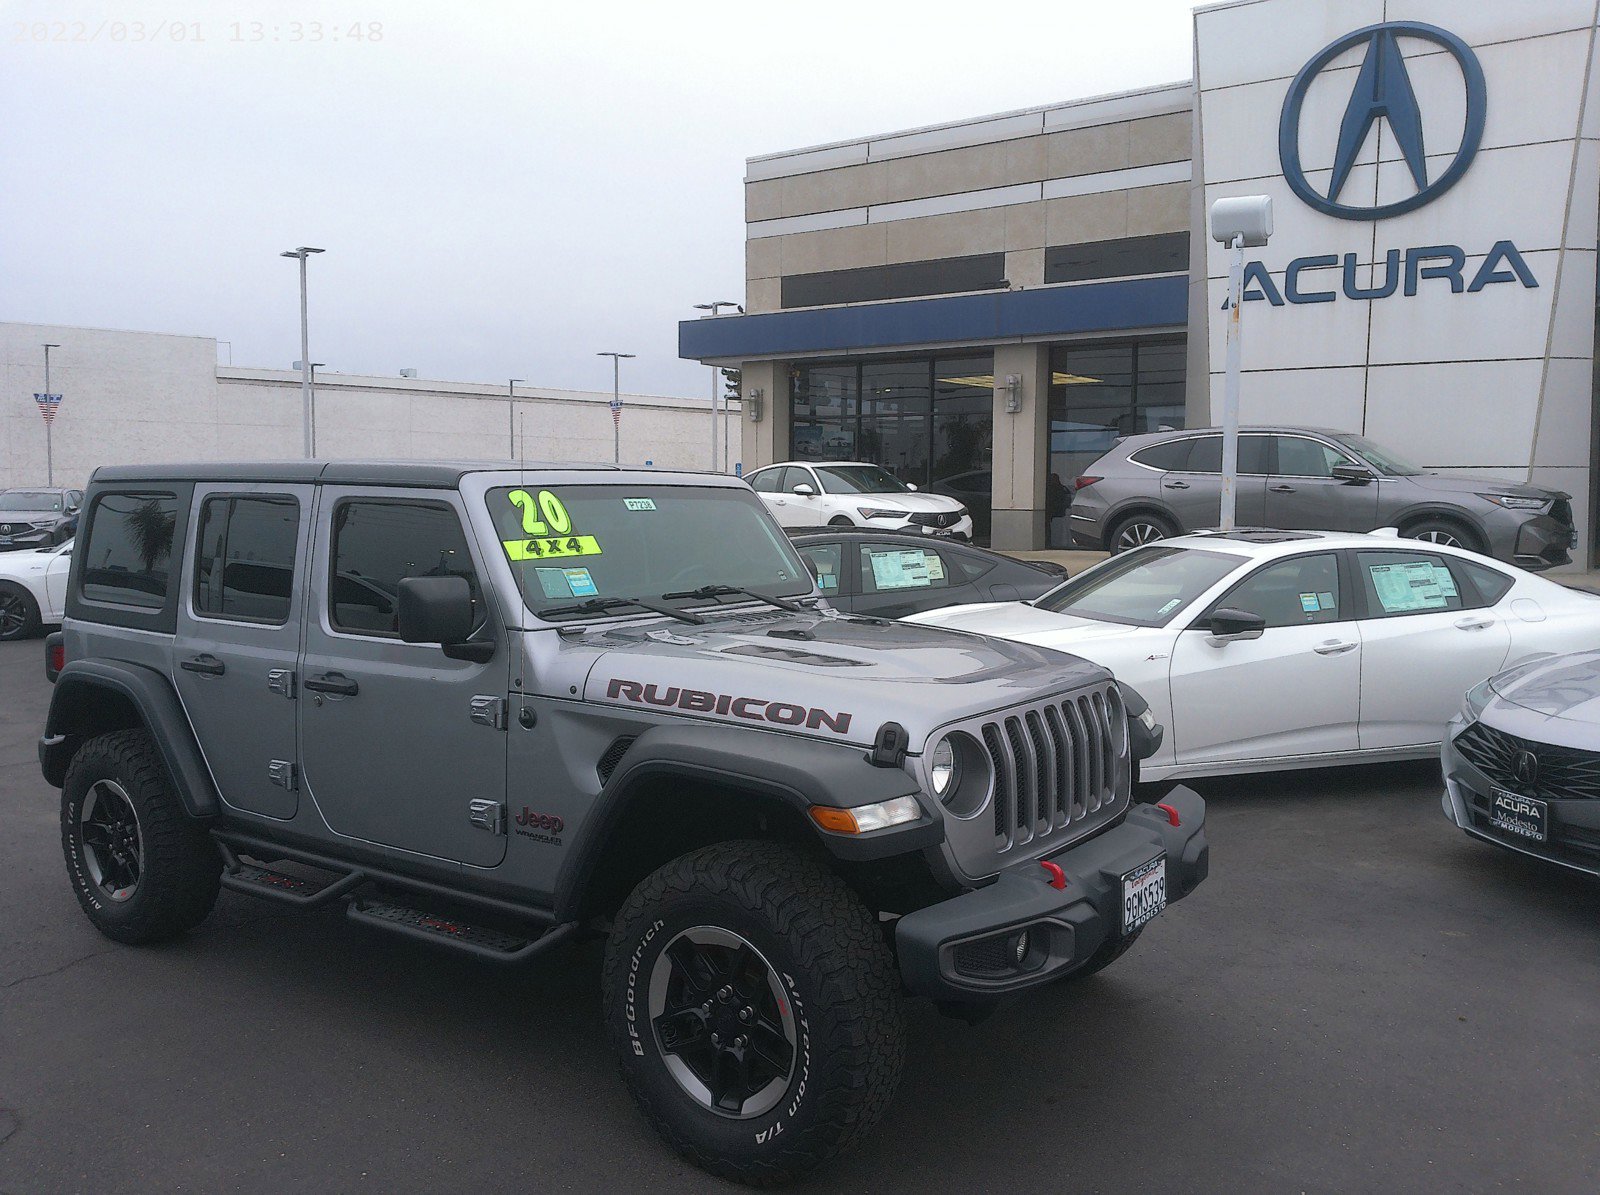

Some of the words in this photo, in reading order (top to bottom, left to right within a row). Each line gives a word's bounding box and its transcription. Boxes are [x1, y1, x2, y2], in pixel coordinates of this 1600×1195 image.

[1221, 240, 1539, 310] ACURA
[508, 489, 572, 536] 20
[606, 678, 853, 734] RUBICON
[515, 805, 564, 836] Jeep
[1495, 796, 1540, 818] ACURA
[1497, 810, 1538, 832] Modesto
[515, 829, 562, 844] WRANGLER
[1500, 822, 1543, 841] MODESTO
[1126, 877, 1165, 925] 9GMS539
[1135, 901, 1166, 927] MODESTO
[626, 919, 664, 1056] BFGoodrich
[756, 1121, 784, 1144] T/A
